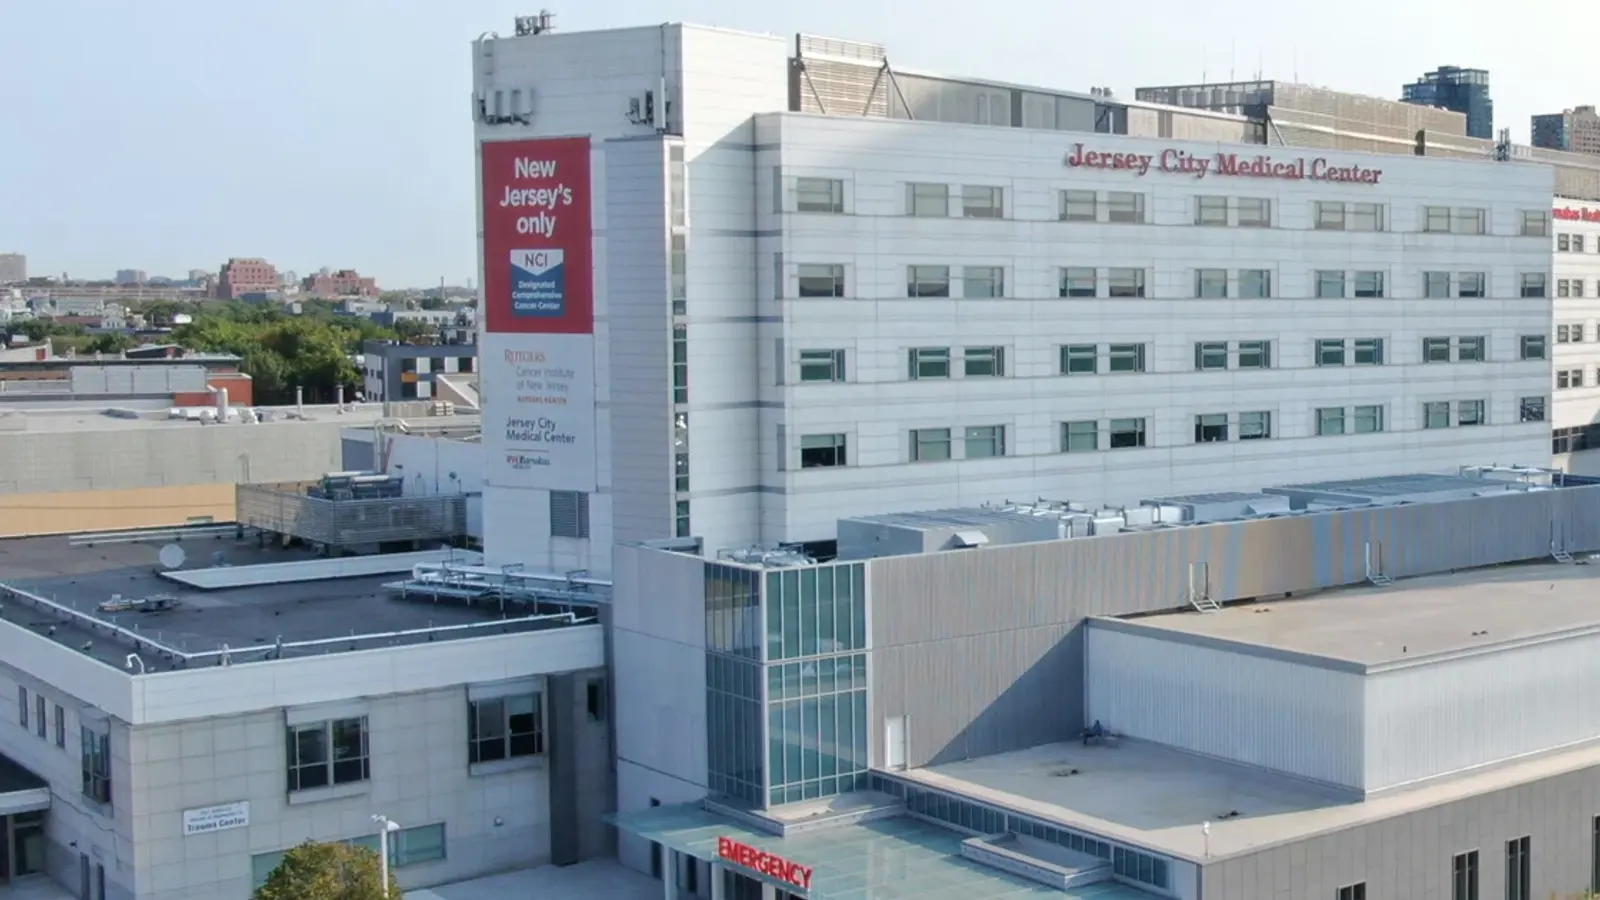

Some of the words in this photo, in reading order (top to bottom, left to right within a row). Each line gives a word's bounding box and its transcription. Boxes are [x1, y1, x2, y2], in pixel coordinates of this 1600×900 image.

[514, 156, 556, 179] New
[1067, 142, 1153, 176] Jersey
[1159, 148, 1211, 179] City
[1216, 152, 1305, 180] Medical
[1308, 157, 1383, 184] Center
[500, 184, 572, 209] Jersey's
[517, 212, 556, 237] only
[525, 253, 548, 267] NCI
[518, 280, 555, 290] Designated
[512, 291, 562, 301] Comprehensive
[515, 302, 537, 310] Cancer
[538, 302, 560, 310] Center
[504, 348, 546, 365] RUTGERS
[516, 366, 542, 378] Cancer
[543, 366, 575, 379] Institute
[516, 379, 525, 390] of
[527, 379, 543, 391] New
[545, 380, 570, 393] Jersey
[506, 416, 536, 432] Jersey
[537, 417, 557, 432] City
[506, 429, 542, 442] Medical
[544, 431, 576, 444] Center
[188, 822, 217, 832] Trauma
[219, 818, 245, 826] Center
[718, 837, 813, 888] EMERGENCY
